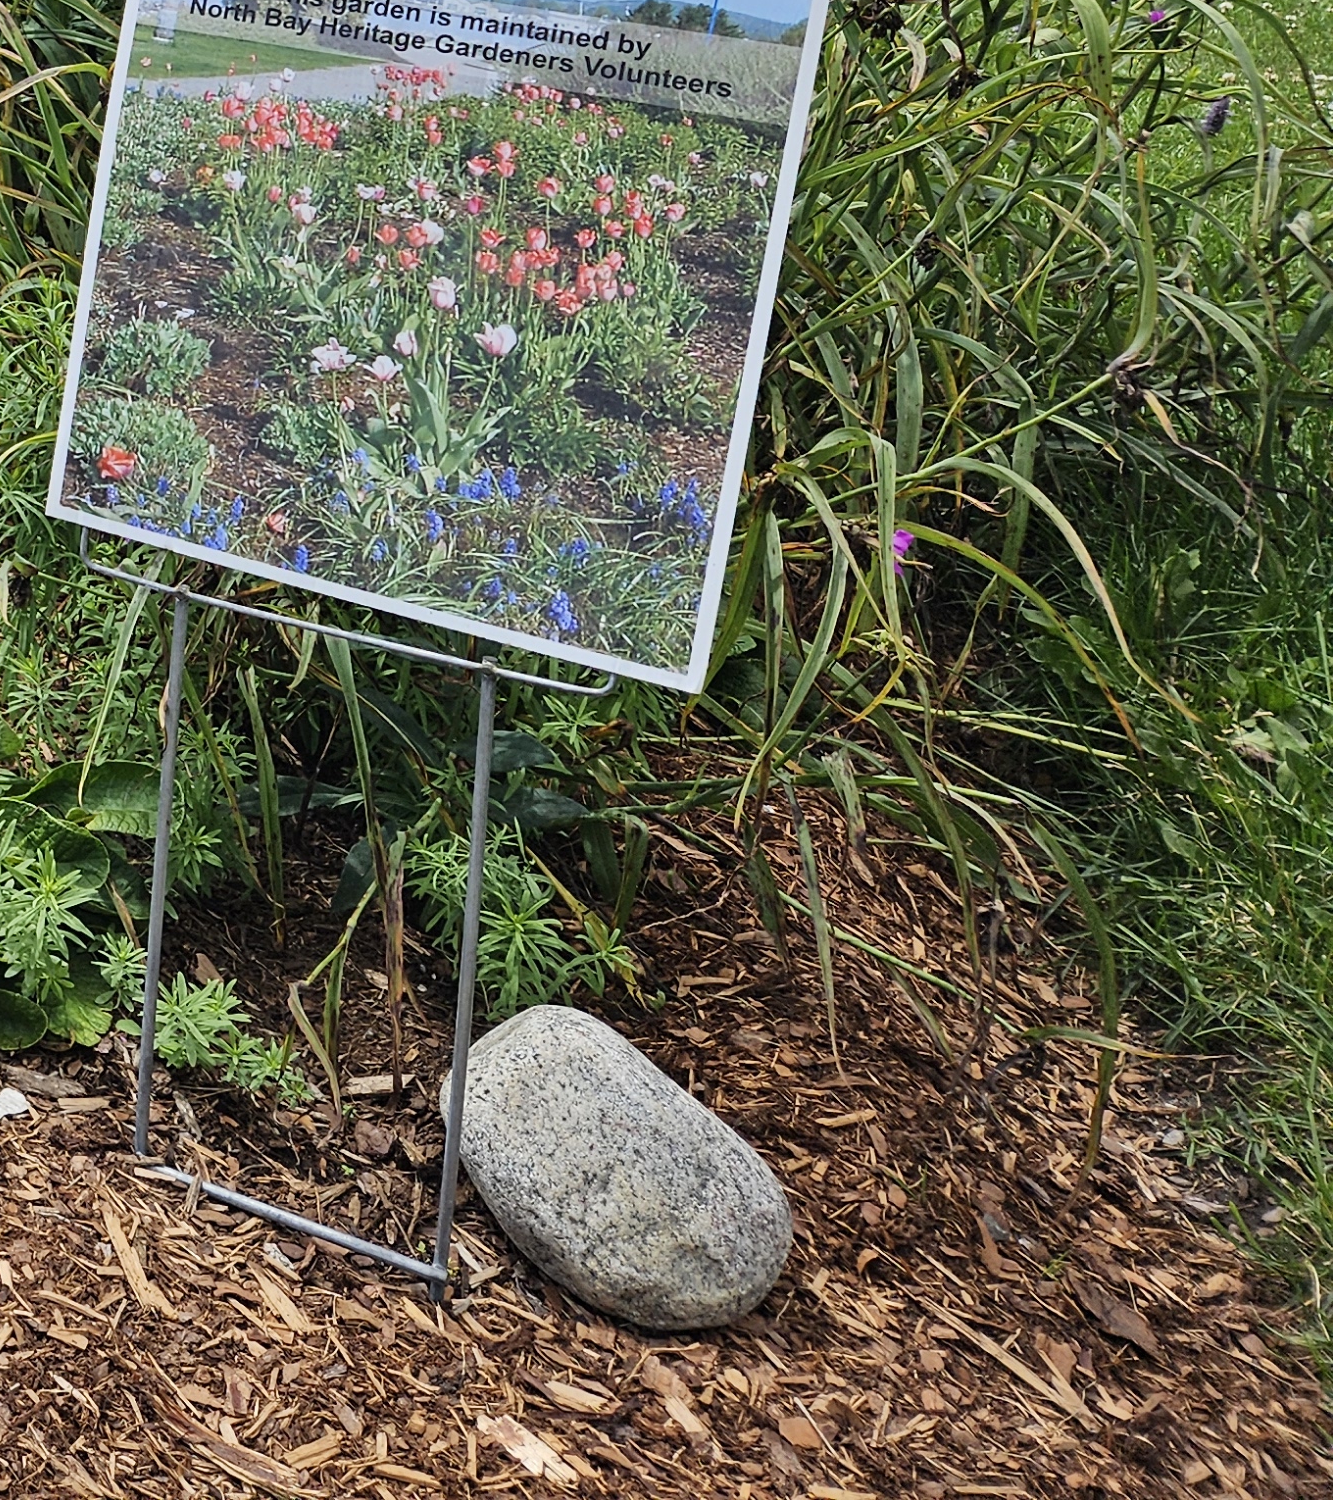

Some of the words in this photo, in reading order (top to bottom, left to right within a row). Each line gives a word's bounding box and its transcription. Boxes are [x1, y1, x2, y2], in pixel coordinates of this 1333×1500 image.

[265, 8, 312, 36] Bay
[320, 15, 426, 50] Heritage
[435, 35, 574, 74] Gardeners
[583, 55, 733, 98] Volunteers
[430, 5, 452, 28] is
[461, 12, 609, 51] maintained
[617, 34, 652, 60] by
